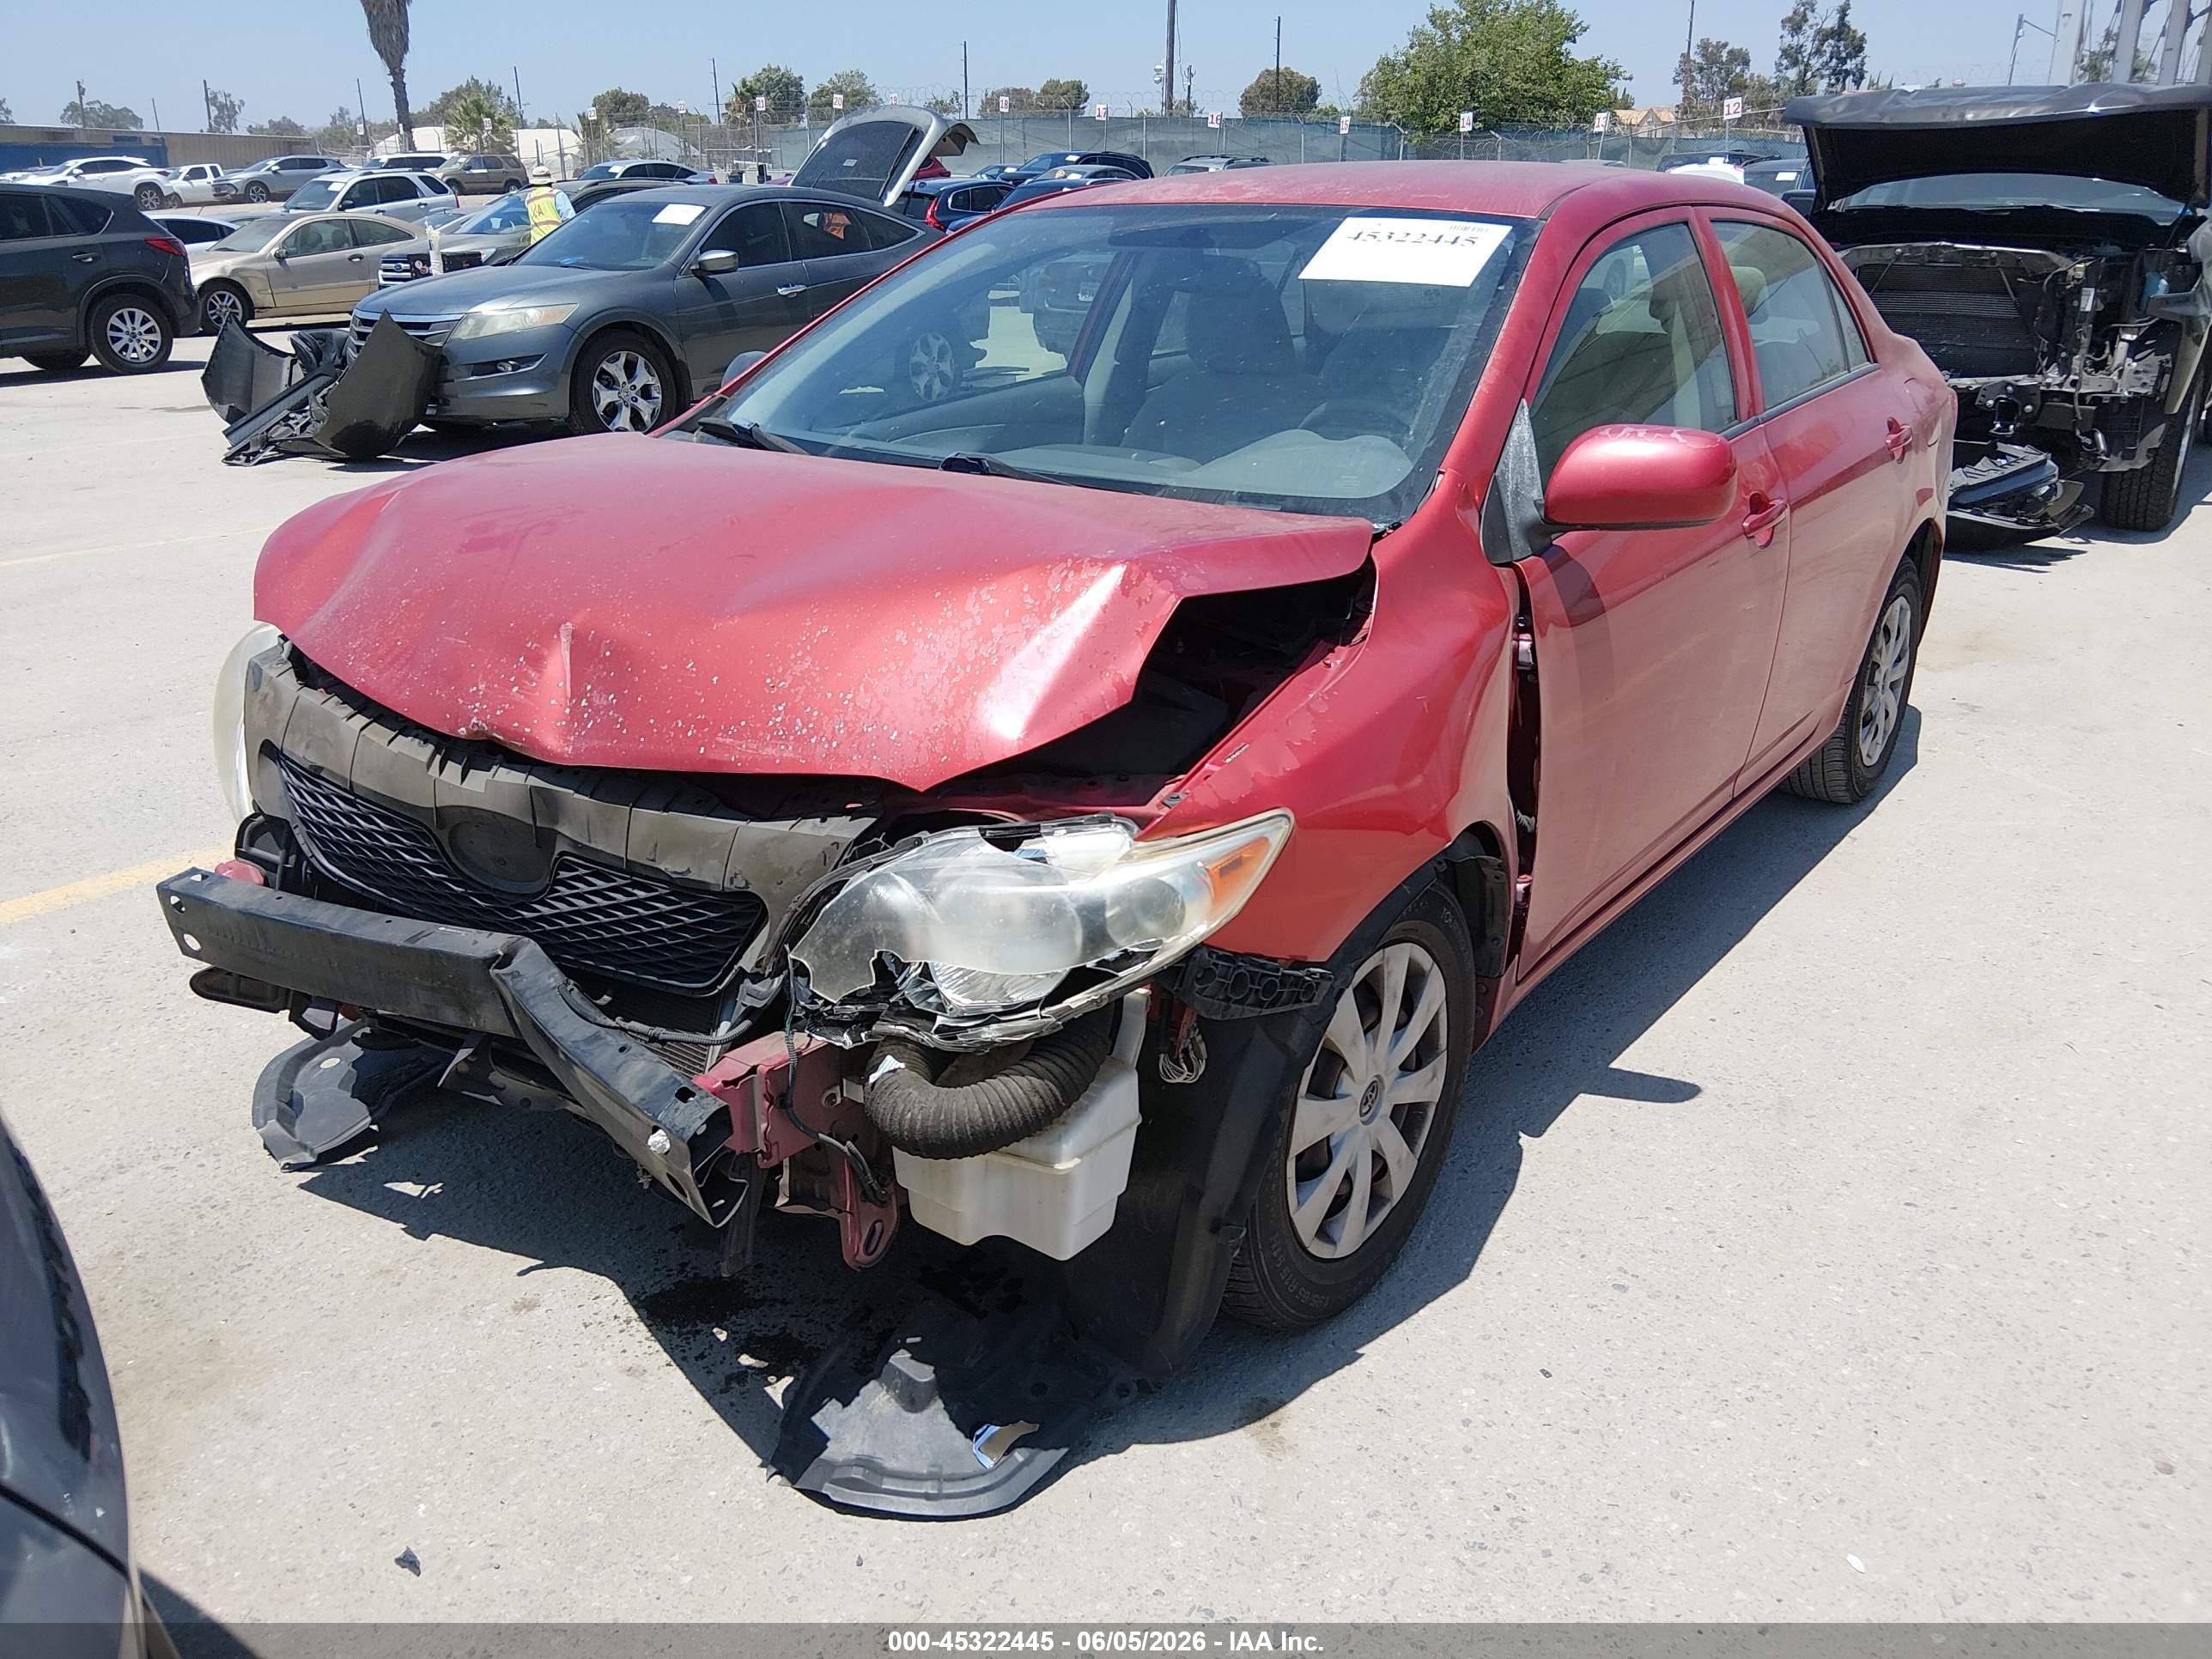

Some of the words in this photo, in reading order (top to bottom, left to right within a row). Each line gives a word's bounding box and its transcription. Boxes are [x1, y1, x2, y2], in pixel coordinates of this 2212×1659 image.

[757, 99, 765, 108] 21
[834, 97, 842, 106] 20
[1000, 99, 1008, 110] 18
[1097, 107, 1107, 118] 17
[1724, 101, 1741, 116] 12
[1461, 115, 1471, 129] 14
[1346, 230, 1479, 247] 45322445
